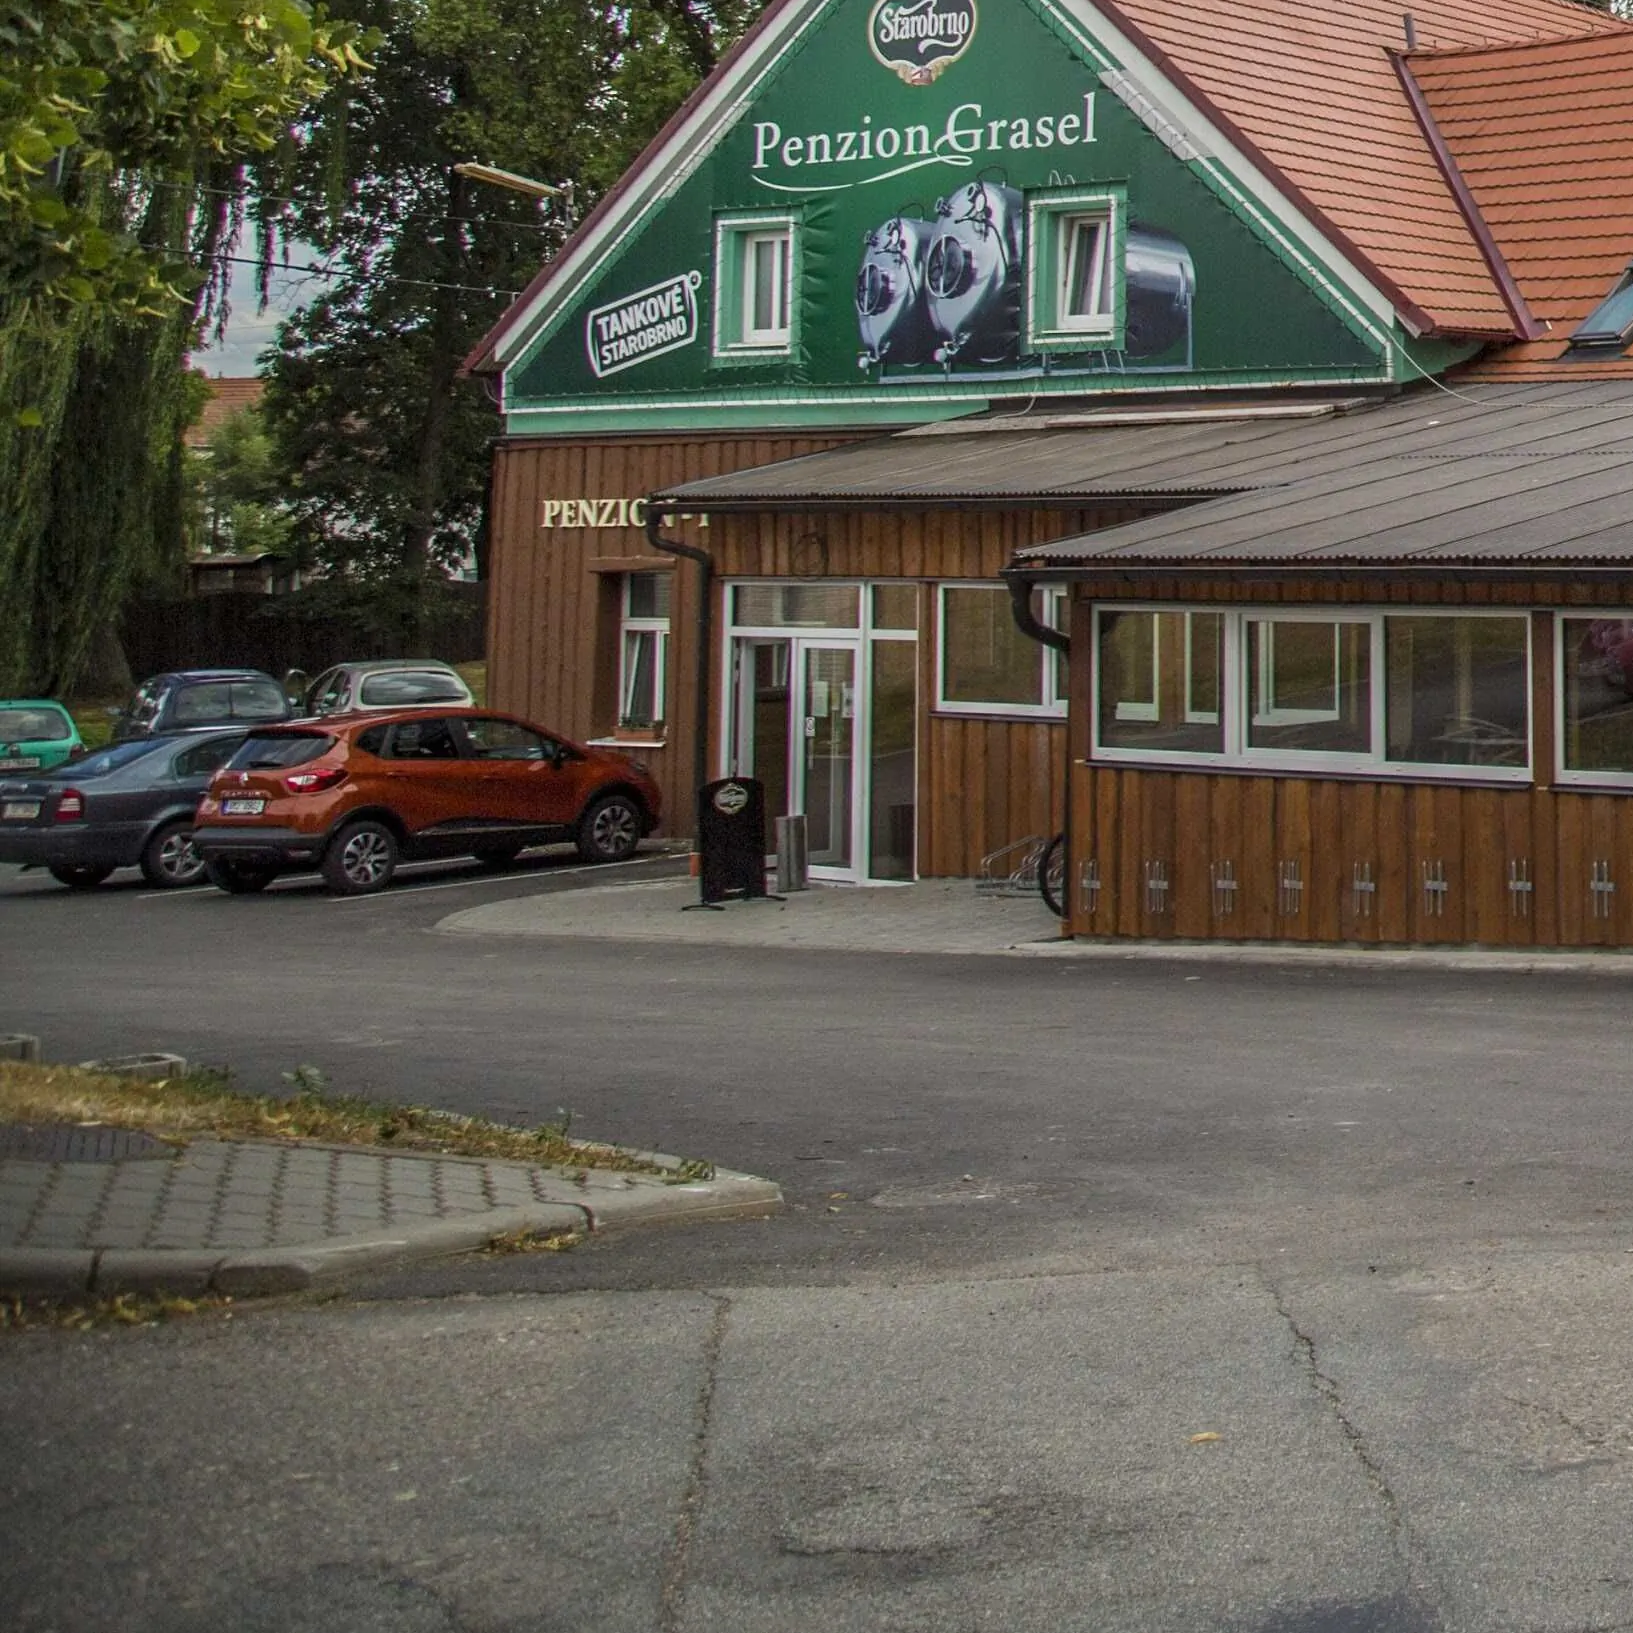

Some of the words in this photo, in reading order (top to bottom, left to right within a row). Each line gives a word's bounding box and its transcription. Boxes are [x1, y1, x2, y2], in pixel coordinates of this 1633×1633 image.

[752, 115, 933, 169] Penzion
[934, 92, 1098, 166] Grasel
[596, 284, 685, 342] TANKOVÉ
[601, 315, 688, 365] STAROBRNO
